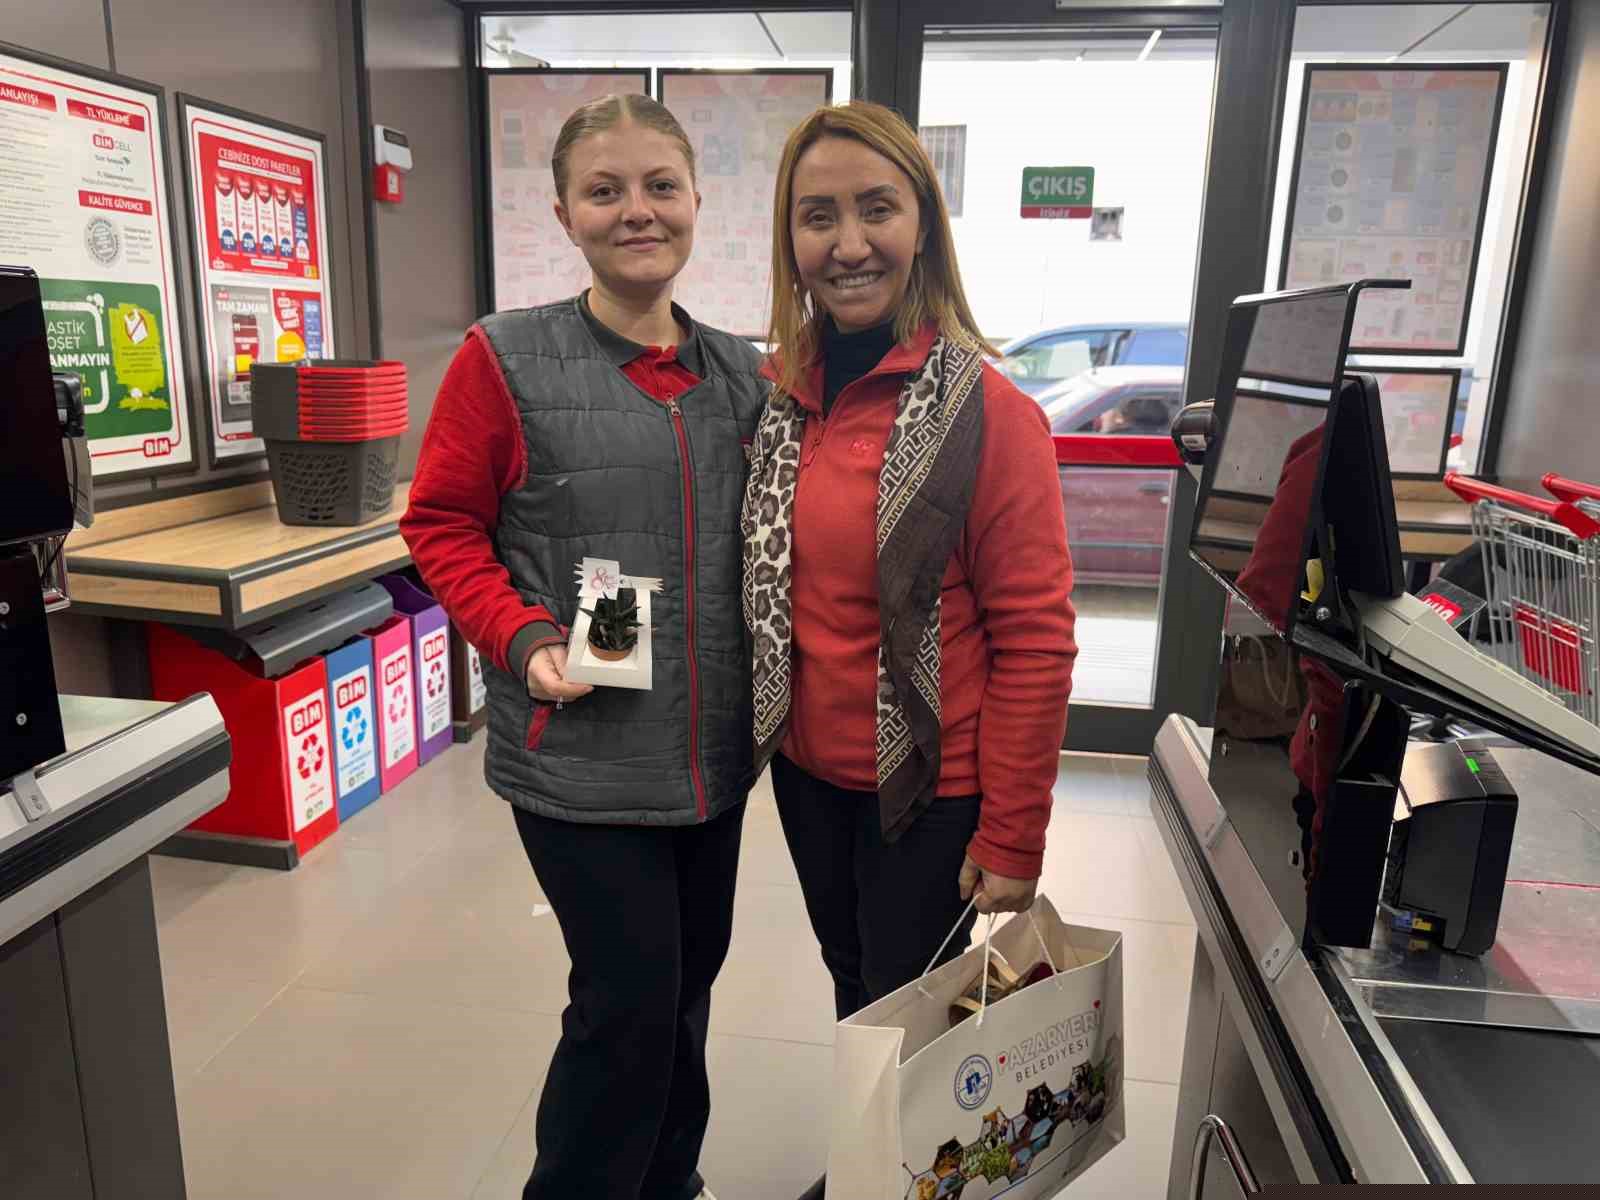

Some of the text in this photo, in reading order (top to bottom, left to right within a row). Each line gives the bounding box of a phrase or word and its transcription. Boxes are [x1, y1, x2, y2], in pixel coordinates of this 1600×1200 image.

[1028, 175, 1087, 200] ÇIKIŞ
[47, 320, 87, 335] ASTİK
[47, 336, 81, 350] OŞET
[50, 353, 110, 368] ANMAYIN
[1015, 1038, 1089, 1082] BELEDİYESİ
